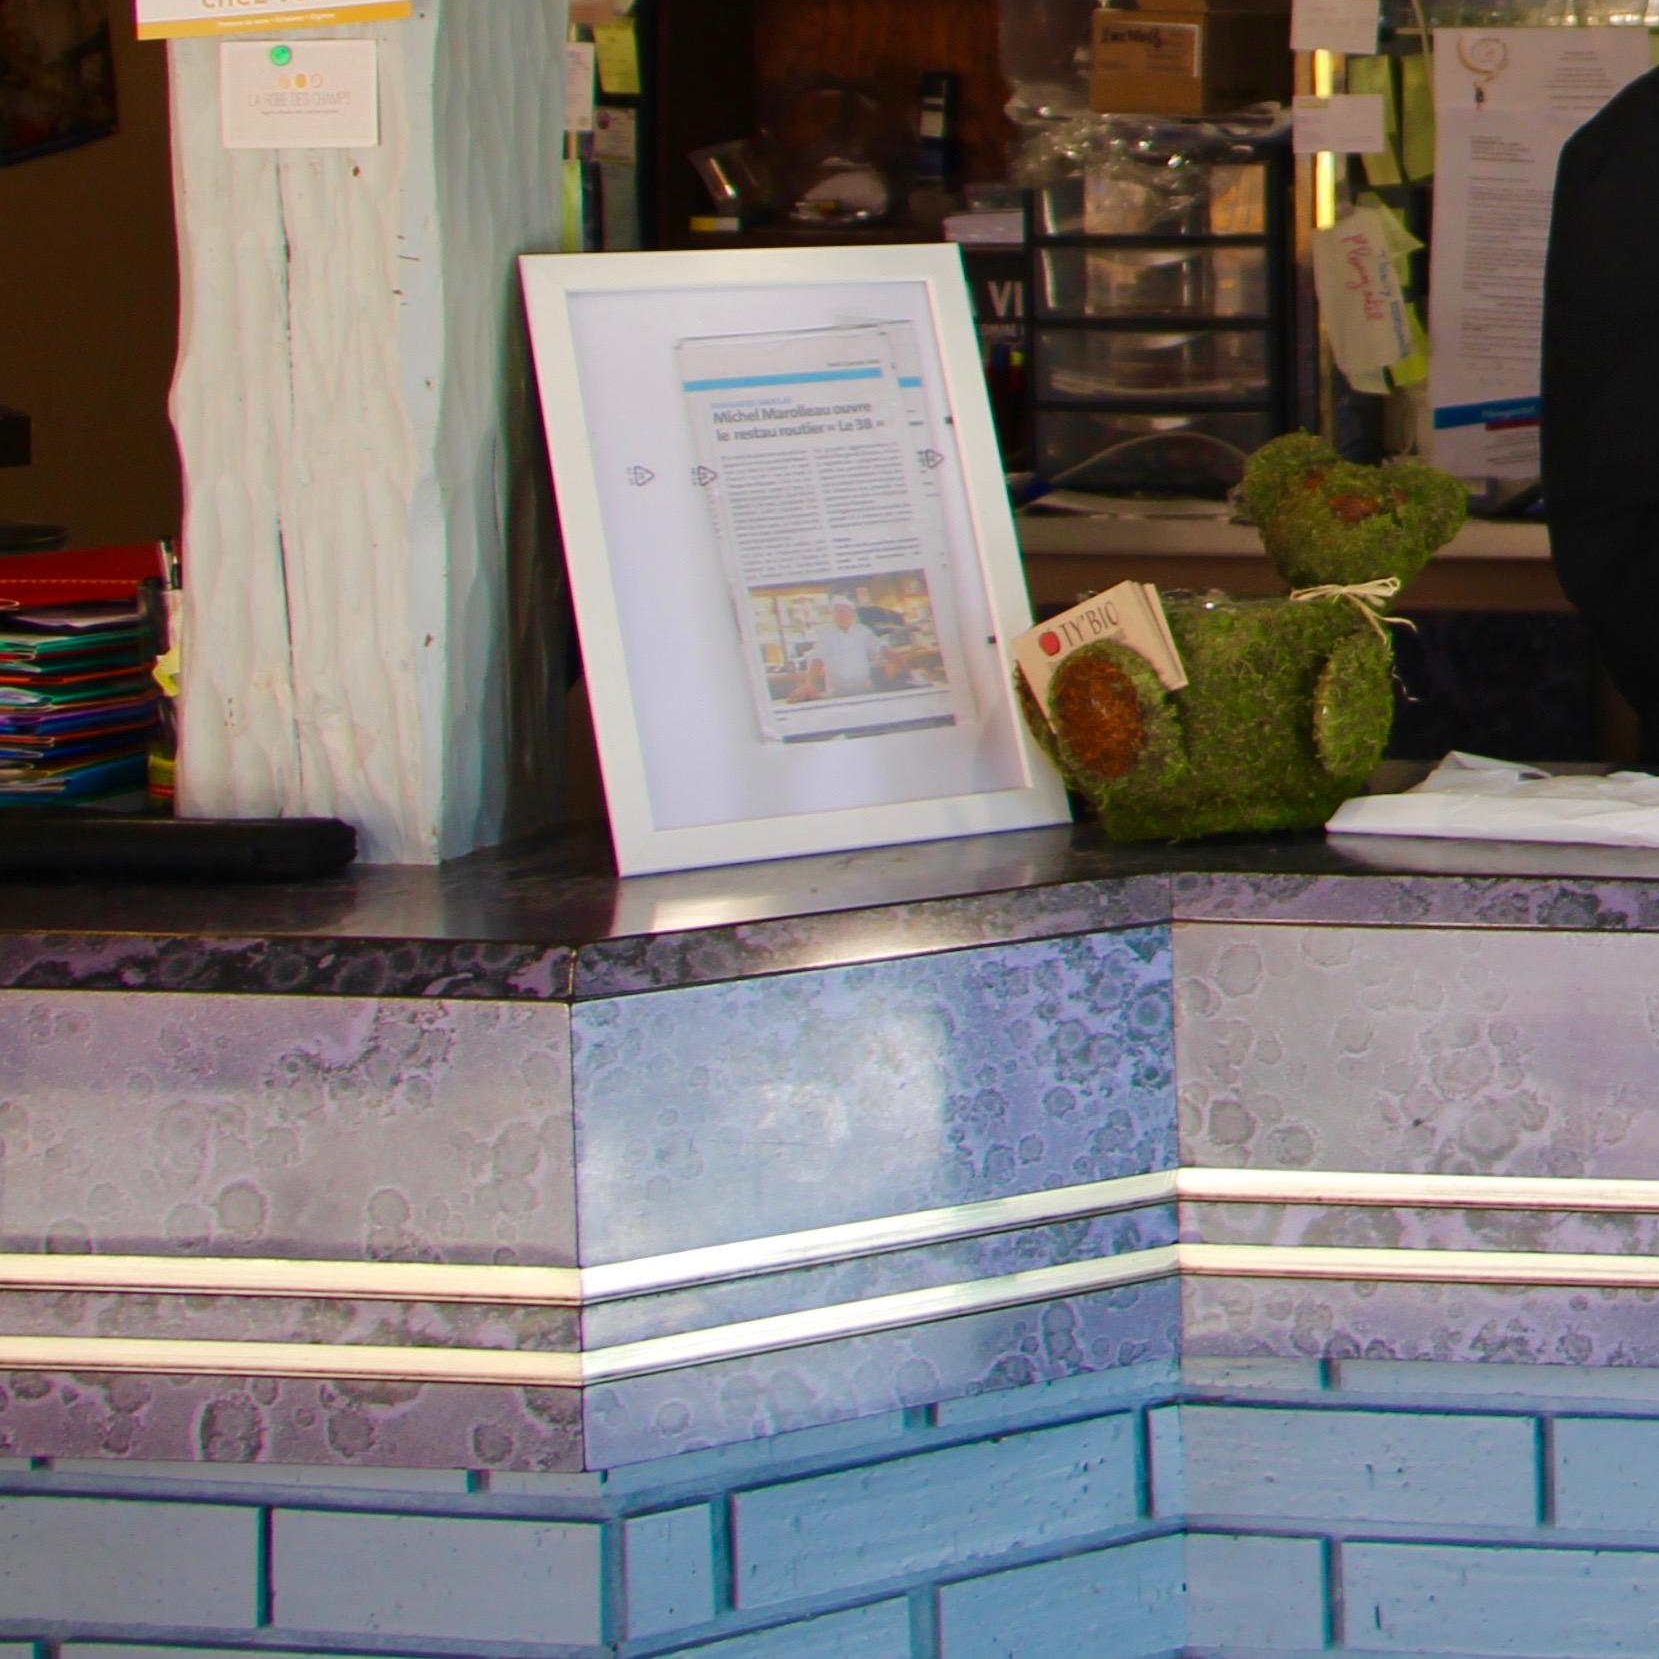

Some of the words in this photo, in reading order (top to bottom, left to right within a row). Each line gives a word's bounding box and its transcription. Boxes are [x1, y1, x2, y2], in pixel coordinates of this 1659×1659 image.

[713, 407, 760, 424] Michel
[833, 403, 871, 415] ouvre
[716, 430, 730, 442] le
[734, 426, 776, 440] restau
[779, 422, 824, 437] routier
[839, 420, 853, 431] Le
[856, 418, 872, 430] 38
[1058, 601, 1120, 648] TY'BIO
